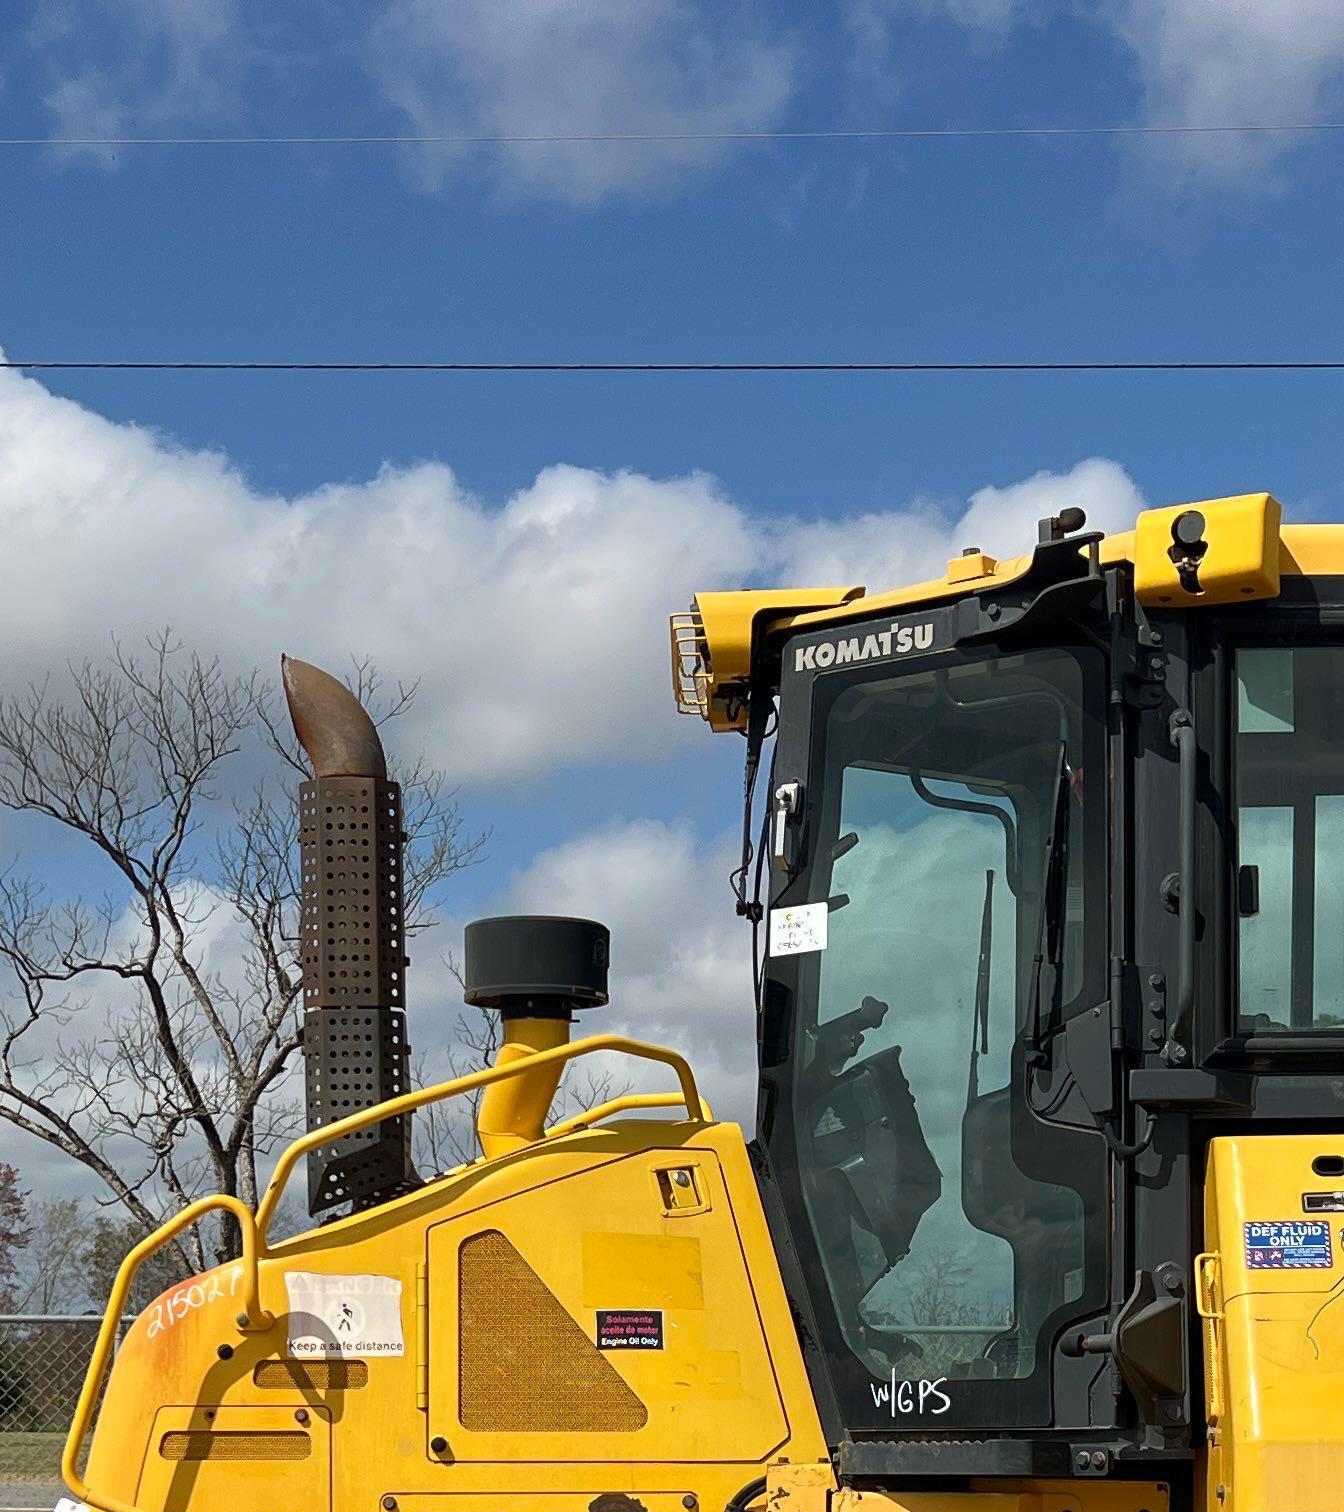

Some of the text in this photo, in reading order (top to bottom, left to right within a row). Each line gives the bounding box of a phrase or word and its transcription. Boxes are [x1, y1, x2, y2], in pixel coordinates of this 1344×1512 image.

[795, 622, 934, 672] KOMATSU
[1251, 1226, 1322, 1237] DEF FLUID
[1269, 1236, 1305, 1246] ONLY
[147, 1265, 245, 1338] 215027
[289, 1341, 403, 1352] Keep a safe distance
[601, 1337, 659, 1346] Engine Oil Only
